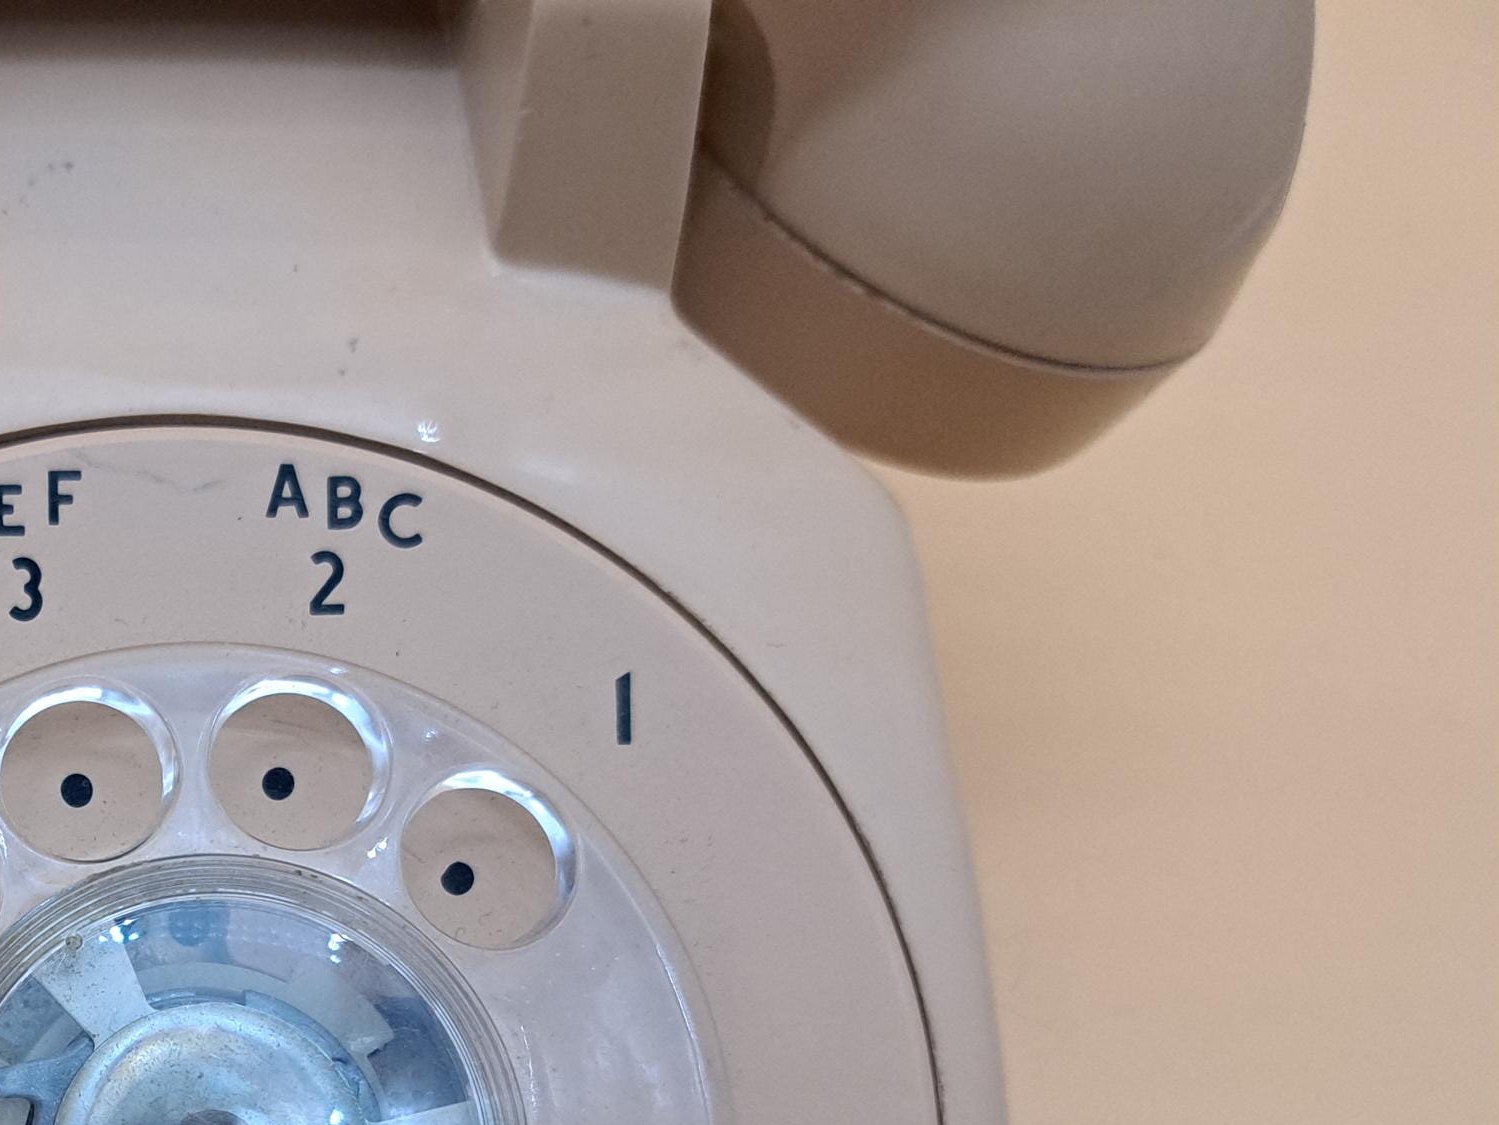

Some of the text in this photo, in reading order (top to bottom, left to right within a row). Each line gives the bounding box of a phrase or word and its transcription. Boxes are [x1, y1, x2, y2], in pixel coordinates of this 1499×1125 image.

[9, 556, 45, 622] 3
[309, 550, 346, 616] 2
[615, 671, 632, 746] 1
